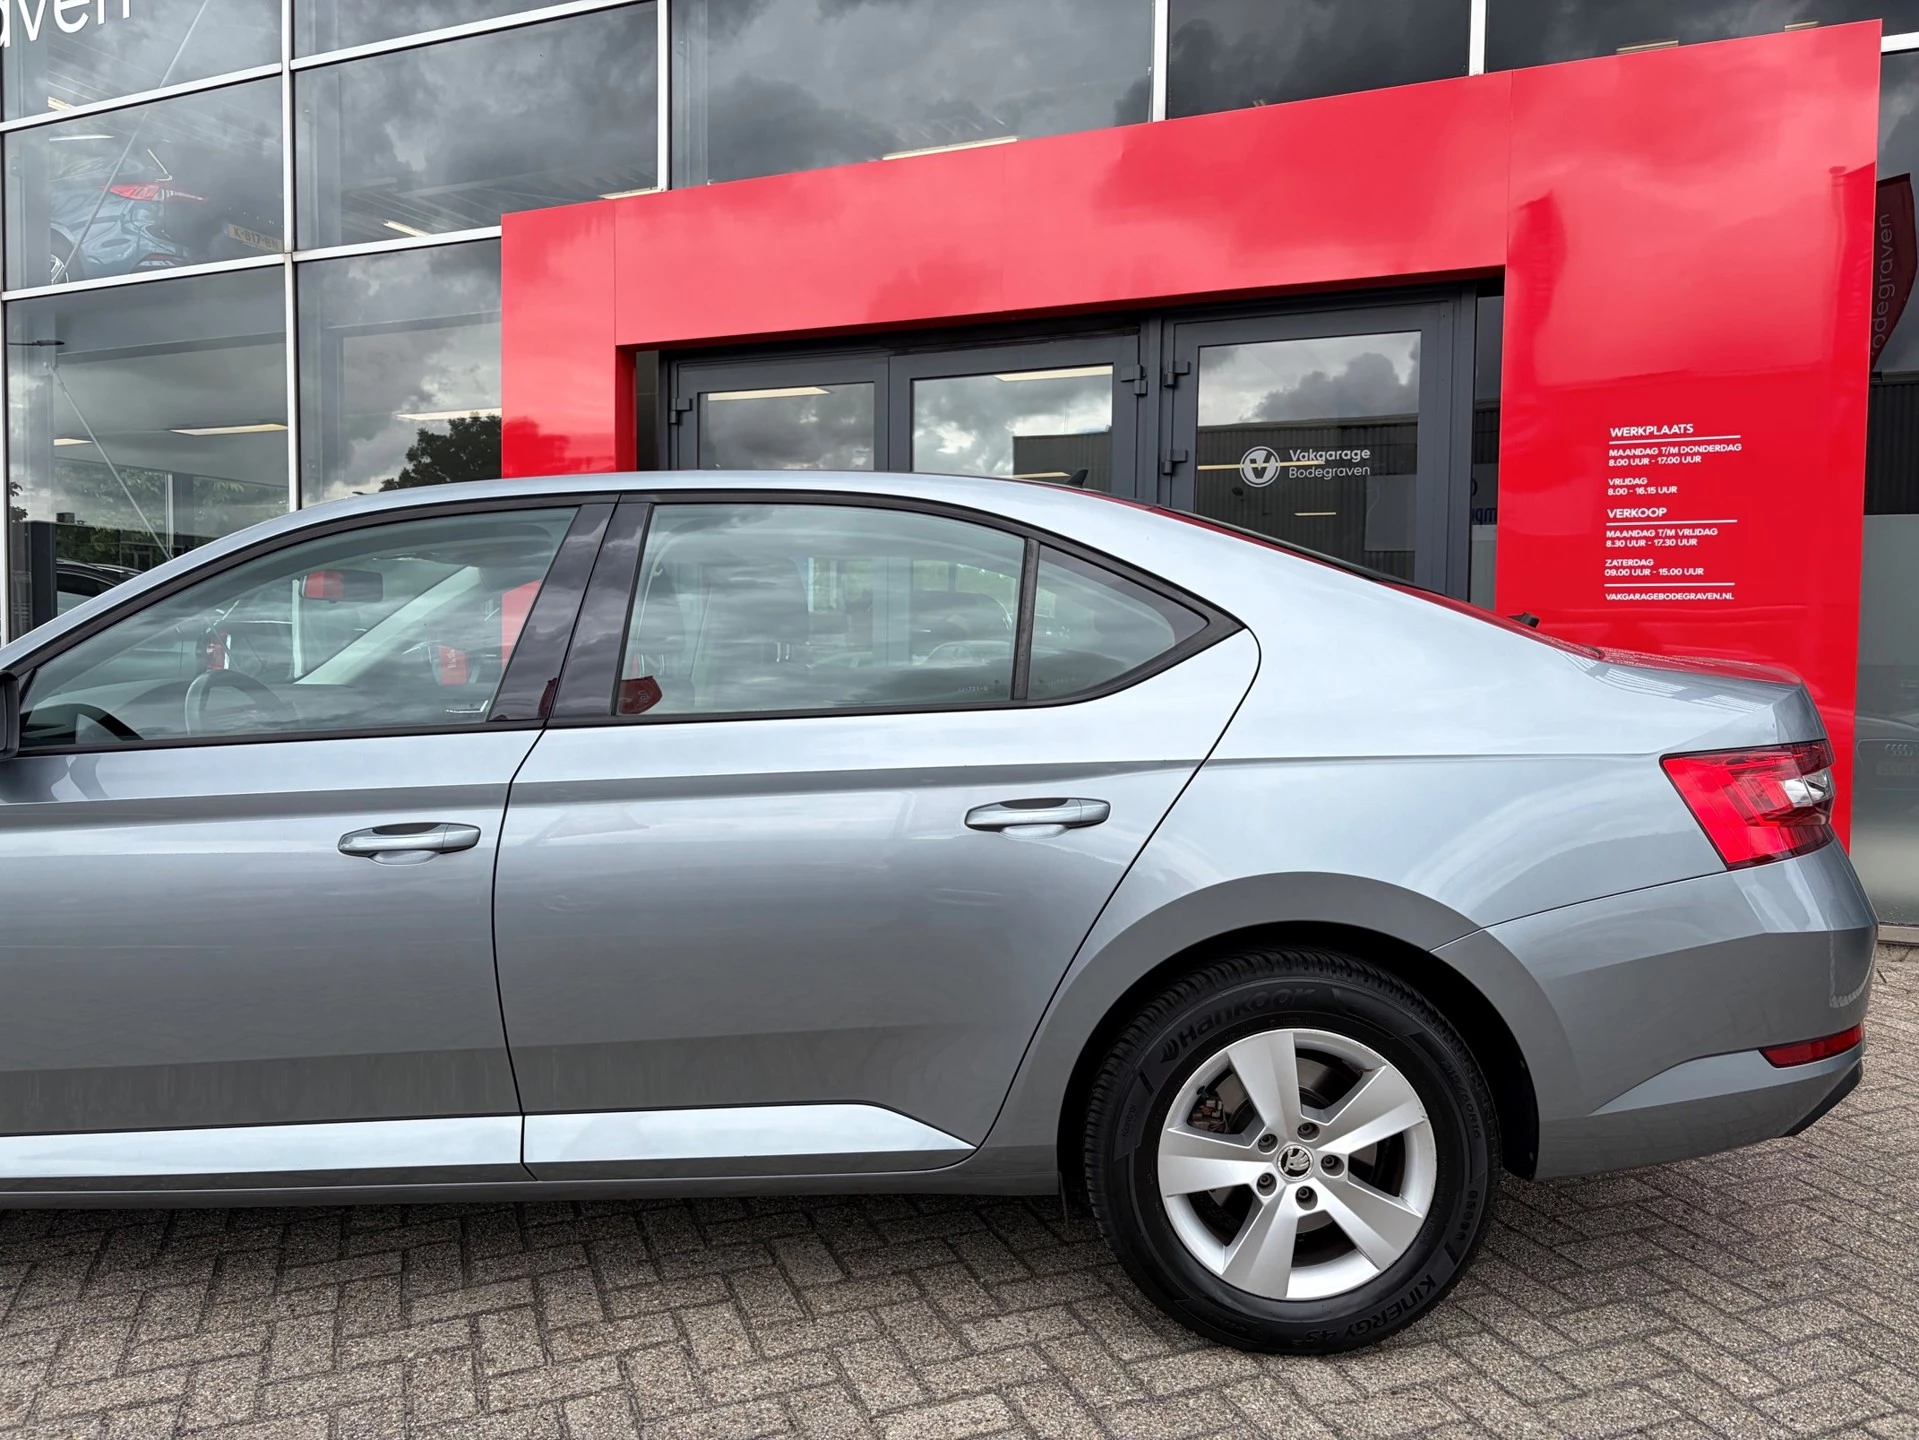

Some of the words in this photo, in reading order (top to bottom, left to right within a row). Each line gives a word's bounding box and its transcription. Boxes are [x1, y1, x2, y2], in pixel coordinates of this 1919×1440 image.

[1871, 213, 1896, 356] odegraven
[1610, 423, 1694, 437] WERKPLAATS
[1289, 449, 1371, 463] Vakgarage
[1609, 447, 1659, 457] MAANDAG
[1660, 445, 1679, 455] T/M
[1680, 443, 1742, 454] DONDERDAG
[1608, 458, 1629, 467] 8.00
[1630, 457, 1650, 466] UUR
[1657, 456, 1681, 465] 17.00
[1682, 455, 1702, 464] UUR
[1289, 466, 1371, 480] Bodegraven
[1608, 477, 1648, 486] VRIJDAG
[1607, 487, 1628, 496] 8.00
[1635, 486, 1657, 495] 16.15
[1658, 485, 1678, 494] UUR
[1607, 507, 1668, 519] VERKOOP
[1606, 529, 1655, 538] MAANDAG
[1657, 528, 1675, 537] T/M
[1677, 527, 1718, 537] VRIJDAG
[1605, 539, 1626, 548] 8.30
[1627, 539, 1646, 547] UUR
[1653, 538, 1676, 547] 17.30
[1677, 538, 1698, 546] UUR
[1605, 558, 1654, 567] ZATERDAG
[1604, 568, 1630, 577] 09.00
[1631, 568, 1651, 576] UUR
[1658, 567, 1683, 576] 15.00
[1684, 567, 1704, 575] UUR
[1605, 592, 1735, 601] VAKGARAGEBODEGRAVEN.NL
[1179, 988, 1316, 1049] Hankook
